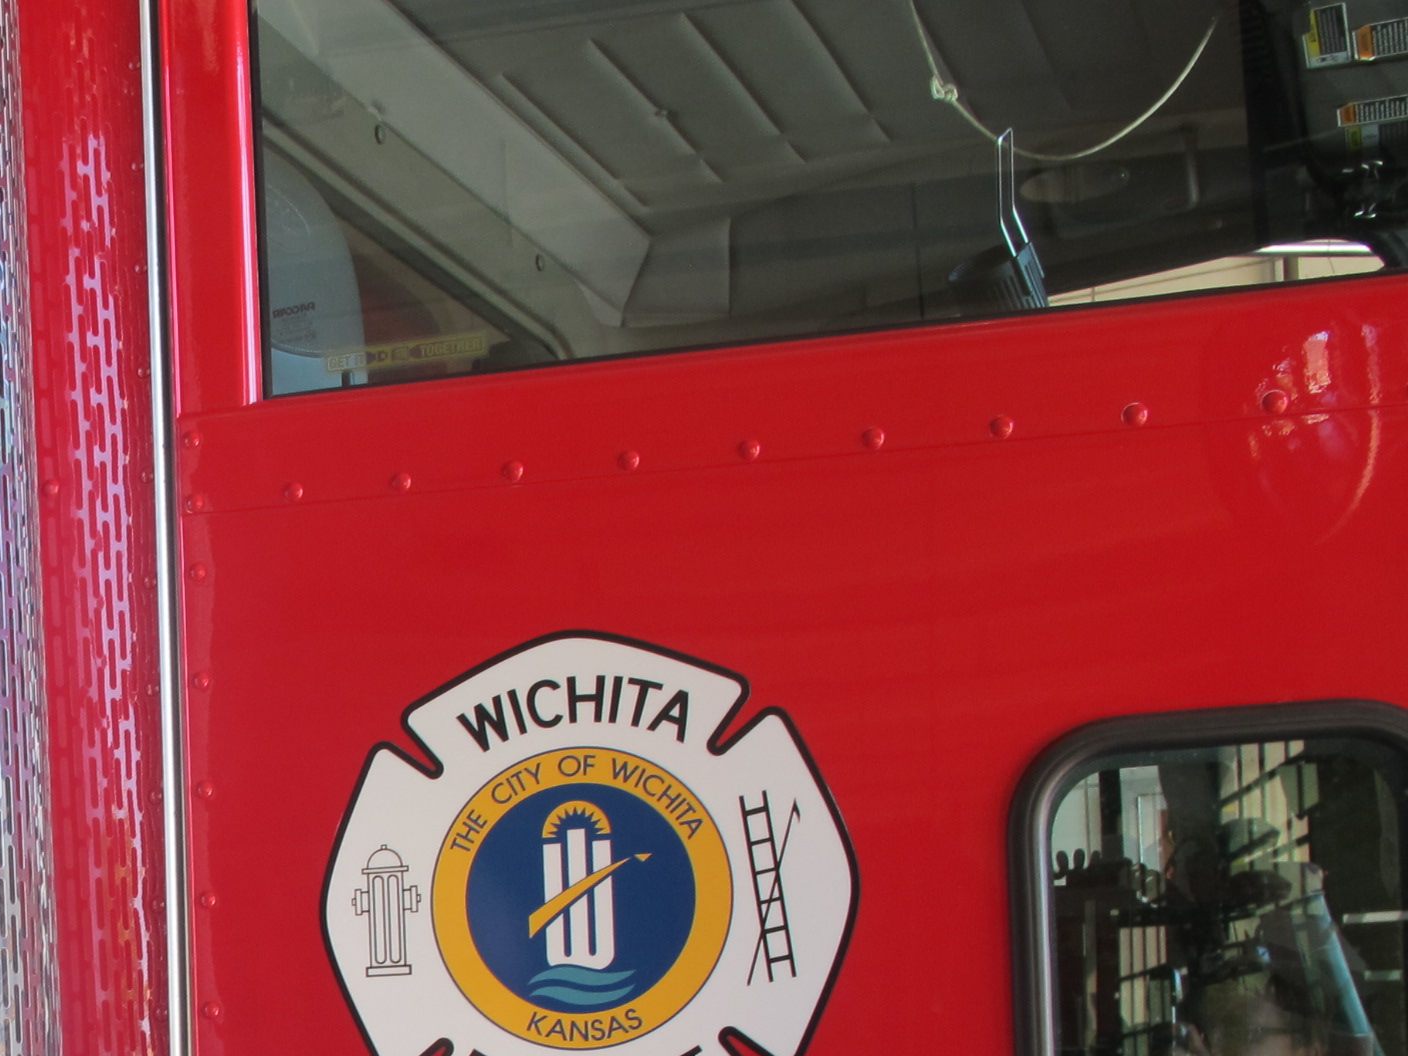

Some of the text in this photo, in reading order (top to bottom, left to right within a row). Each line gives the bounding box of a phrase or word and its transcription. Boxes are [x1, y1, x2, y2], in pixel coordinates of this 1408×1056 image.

[457, 675, 690, 752] WICHITA
[450, 755, 705, 854] THE CITY OF WICHITA
[526, 1008, 643, 1042] KANSAS
